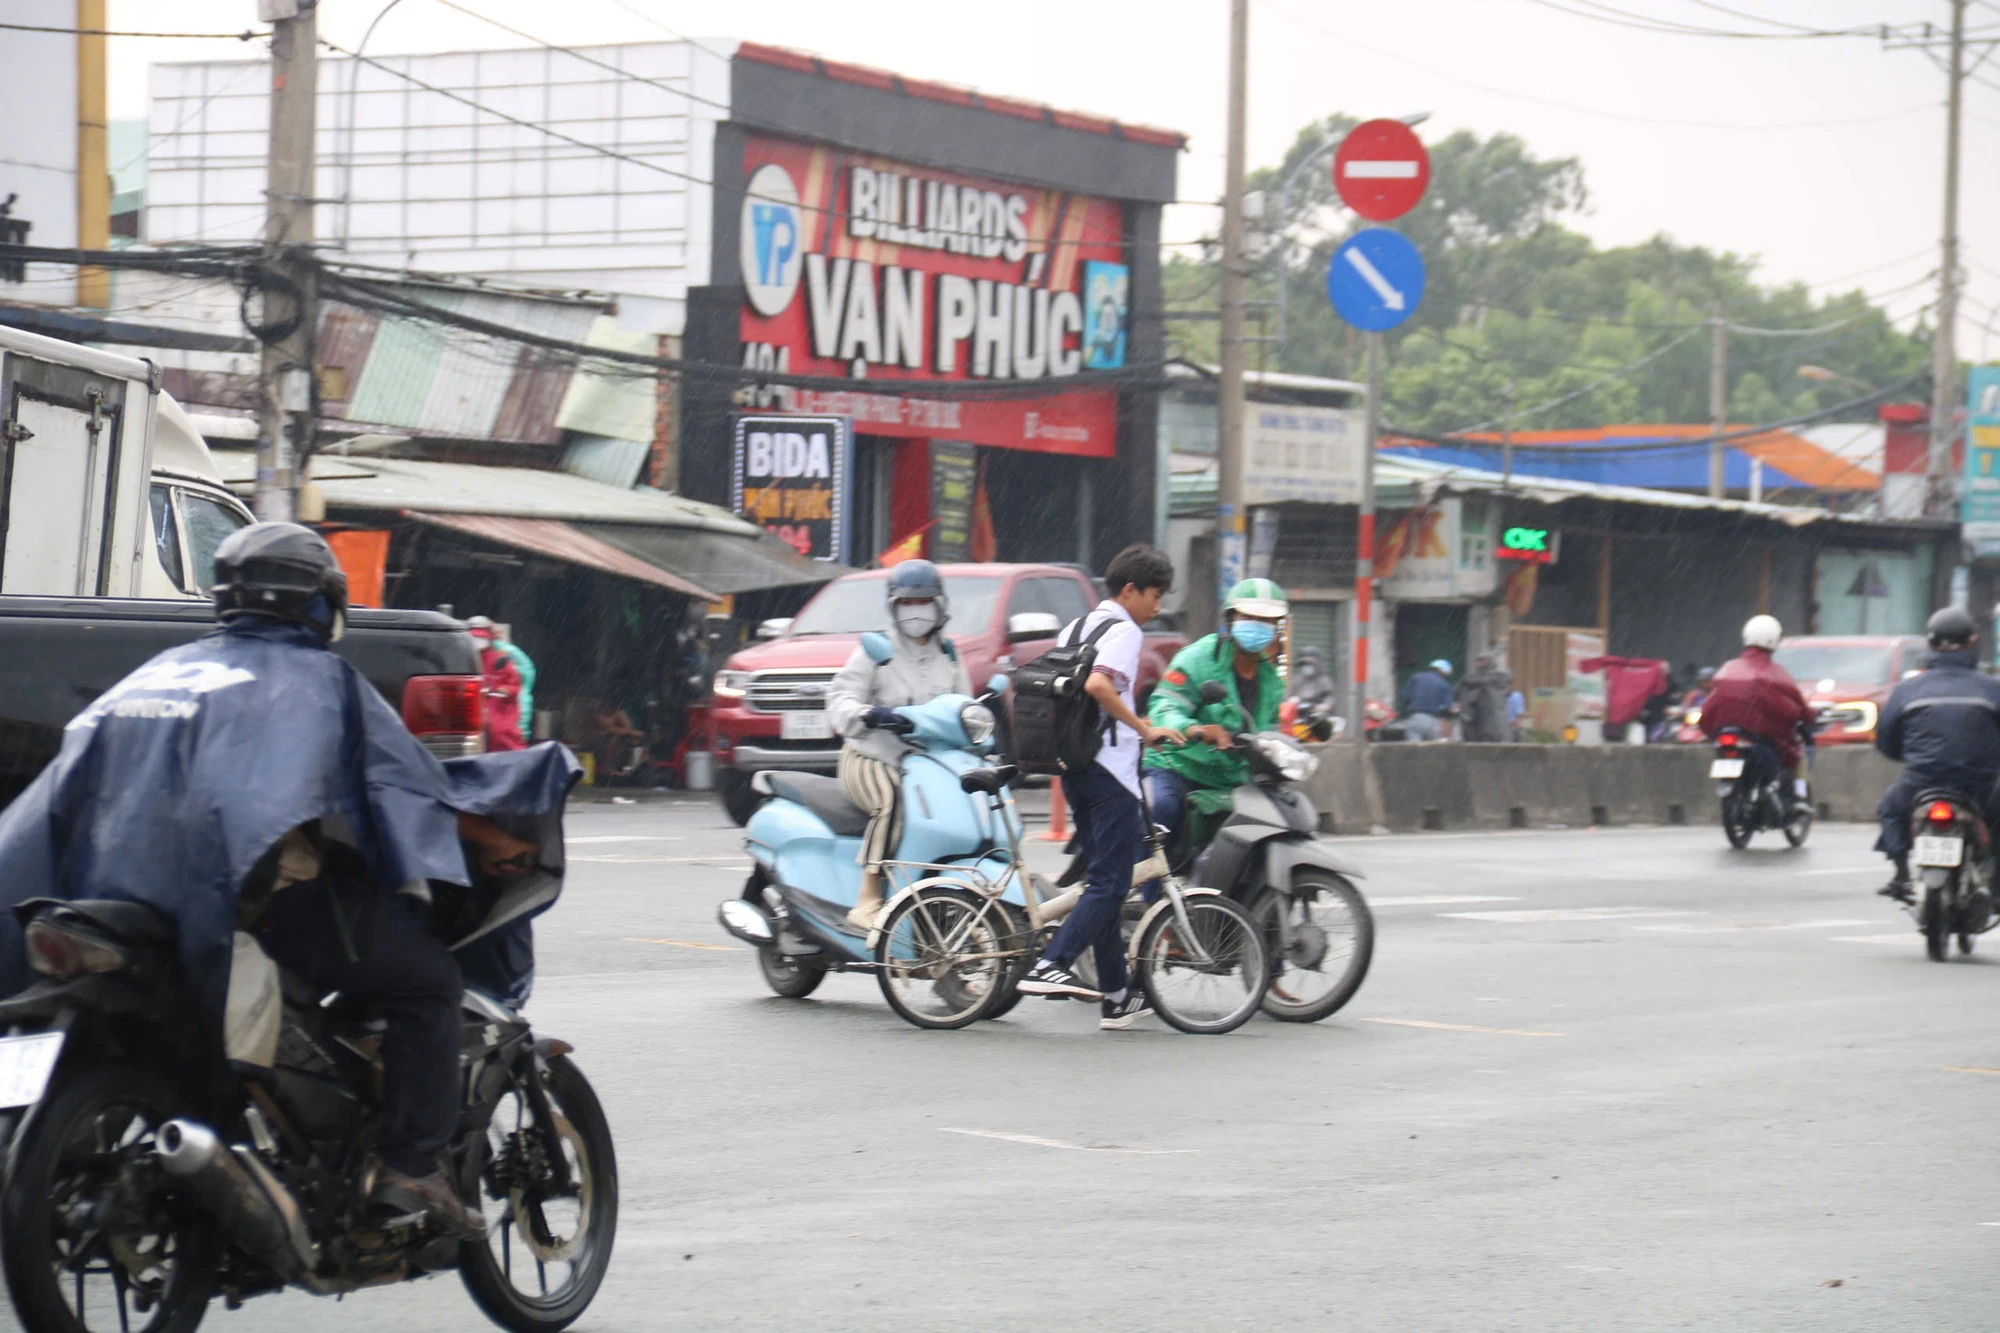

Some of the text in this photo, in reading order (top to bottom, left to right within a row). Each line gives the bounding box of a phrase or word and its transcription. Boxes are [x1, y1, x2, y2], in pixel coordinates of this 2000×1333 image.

[851, 166, 1028, 262] BILLIARDS
[807, 252, 1082, 380] VẠN PHÚC
[747, 432, 830, 478] BIDA
